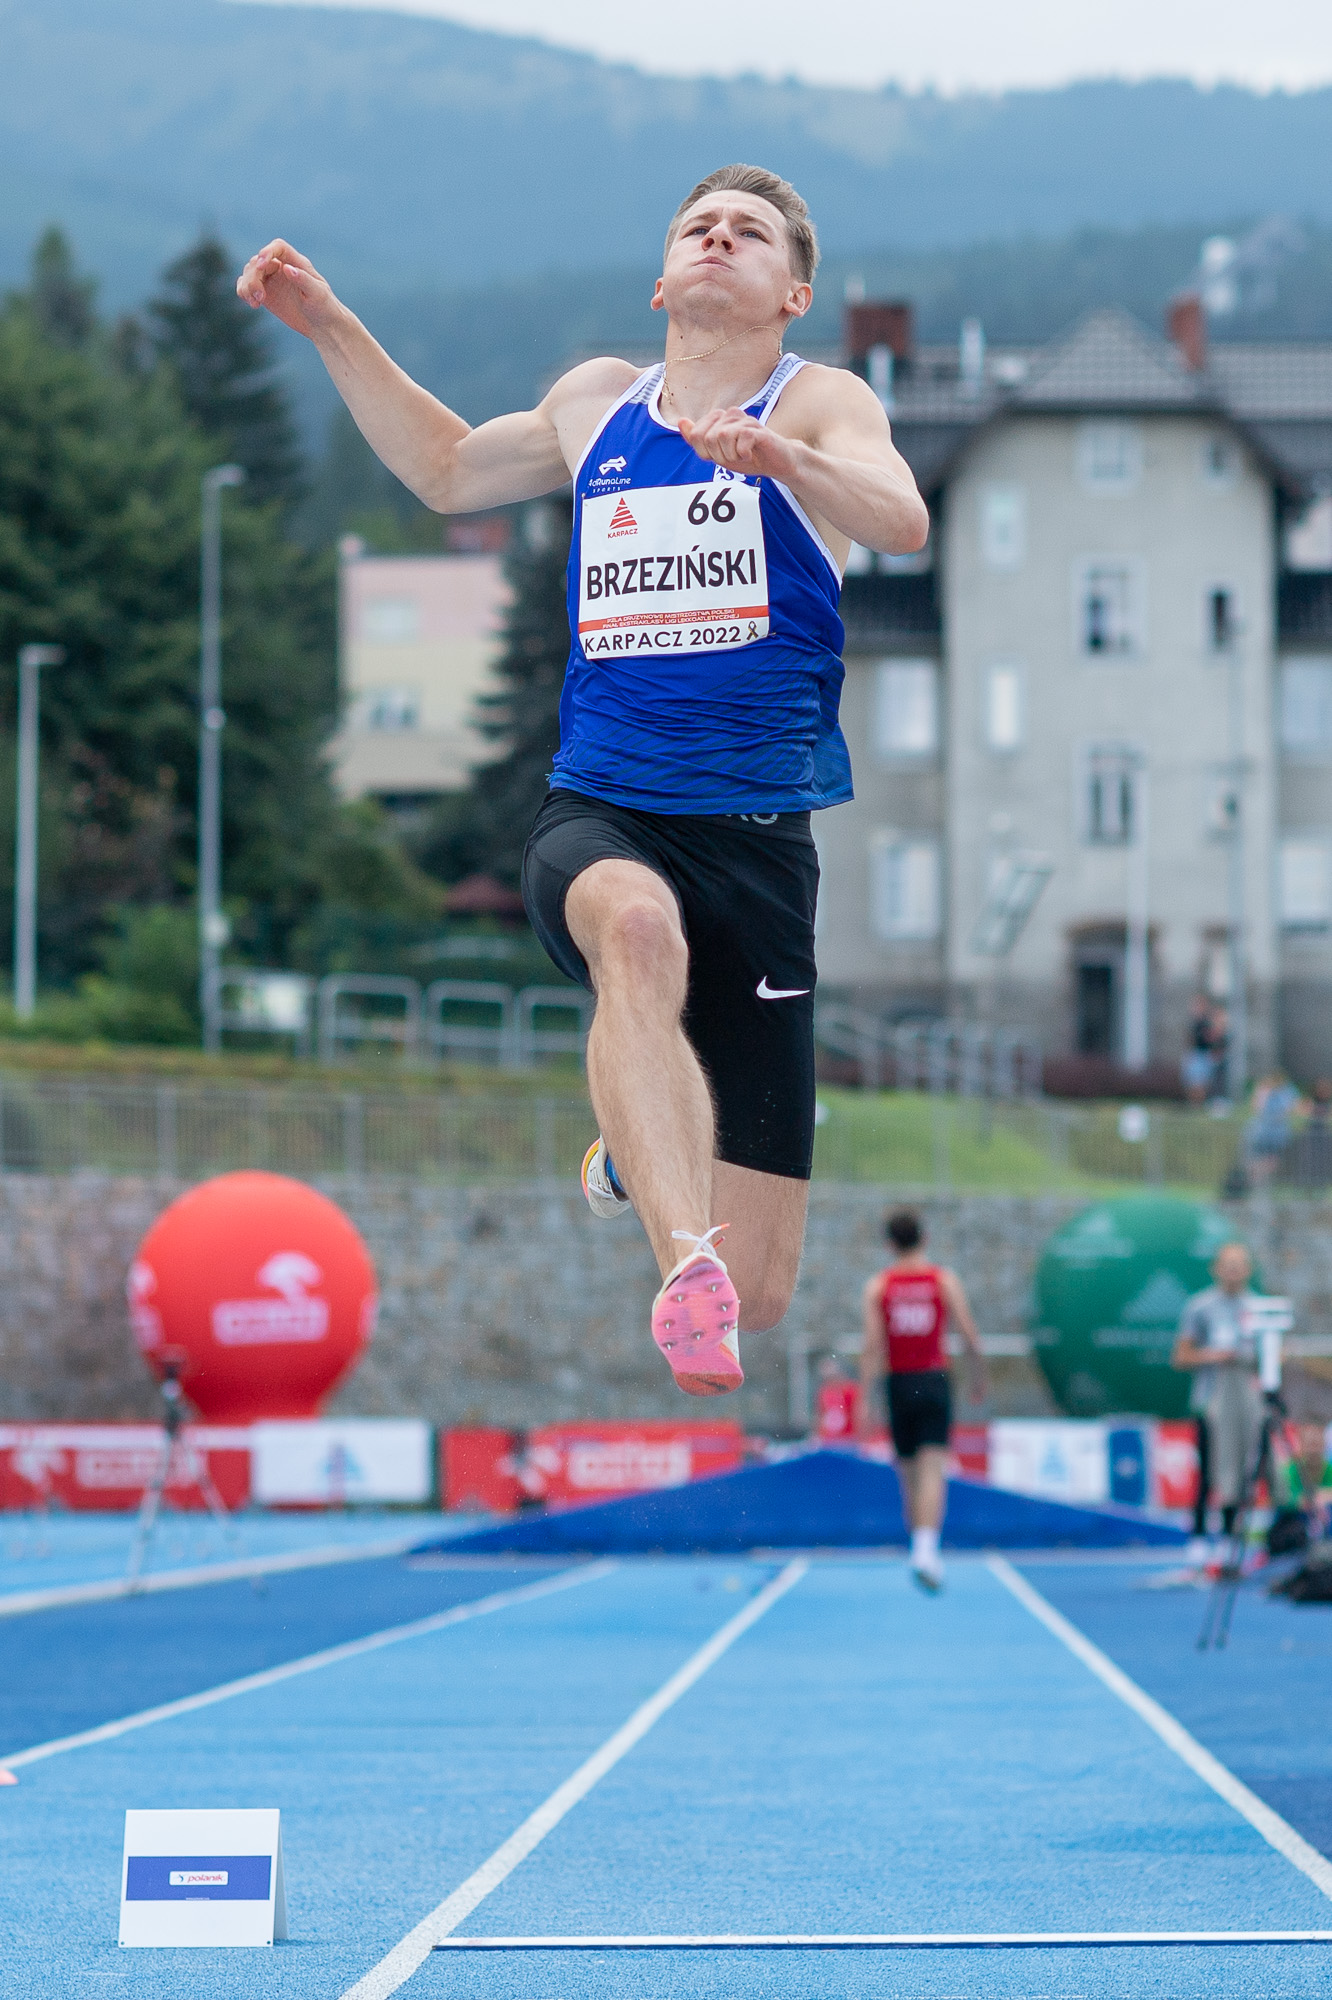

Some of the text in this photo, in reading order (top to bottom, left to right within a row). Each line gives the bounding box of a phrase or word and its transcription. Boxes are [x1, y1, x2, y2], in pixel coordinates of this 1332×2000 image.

[688, 487, 736, 525] 66
[607, 528, 638, 539] KARPACZ
[587, 545, 757, 600] BRZEZIŃSKI
[585, 626, 741, 654] KARPACZ 2022
[187, 1874, 223, 1884] polanik
